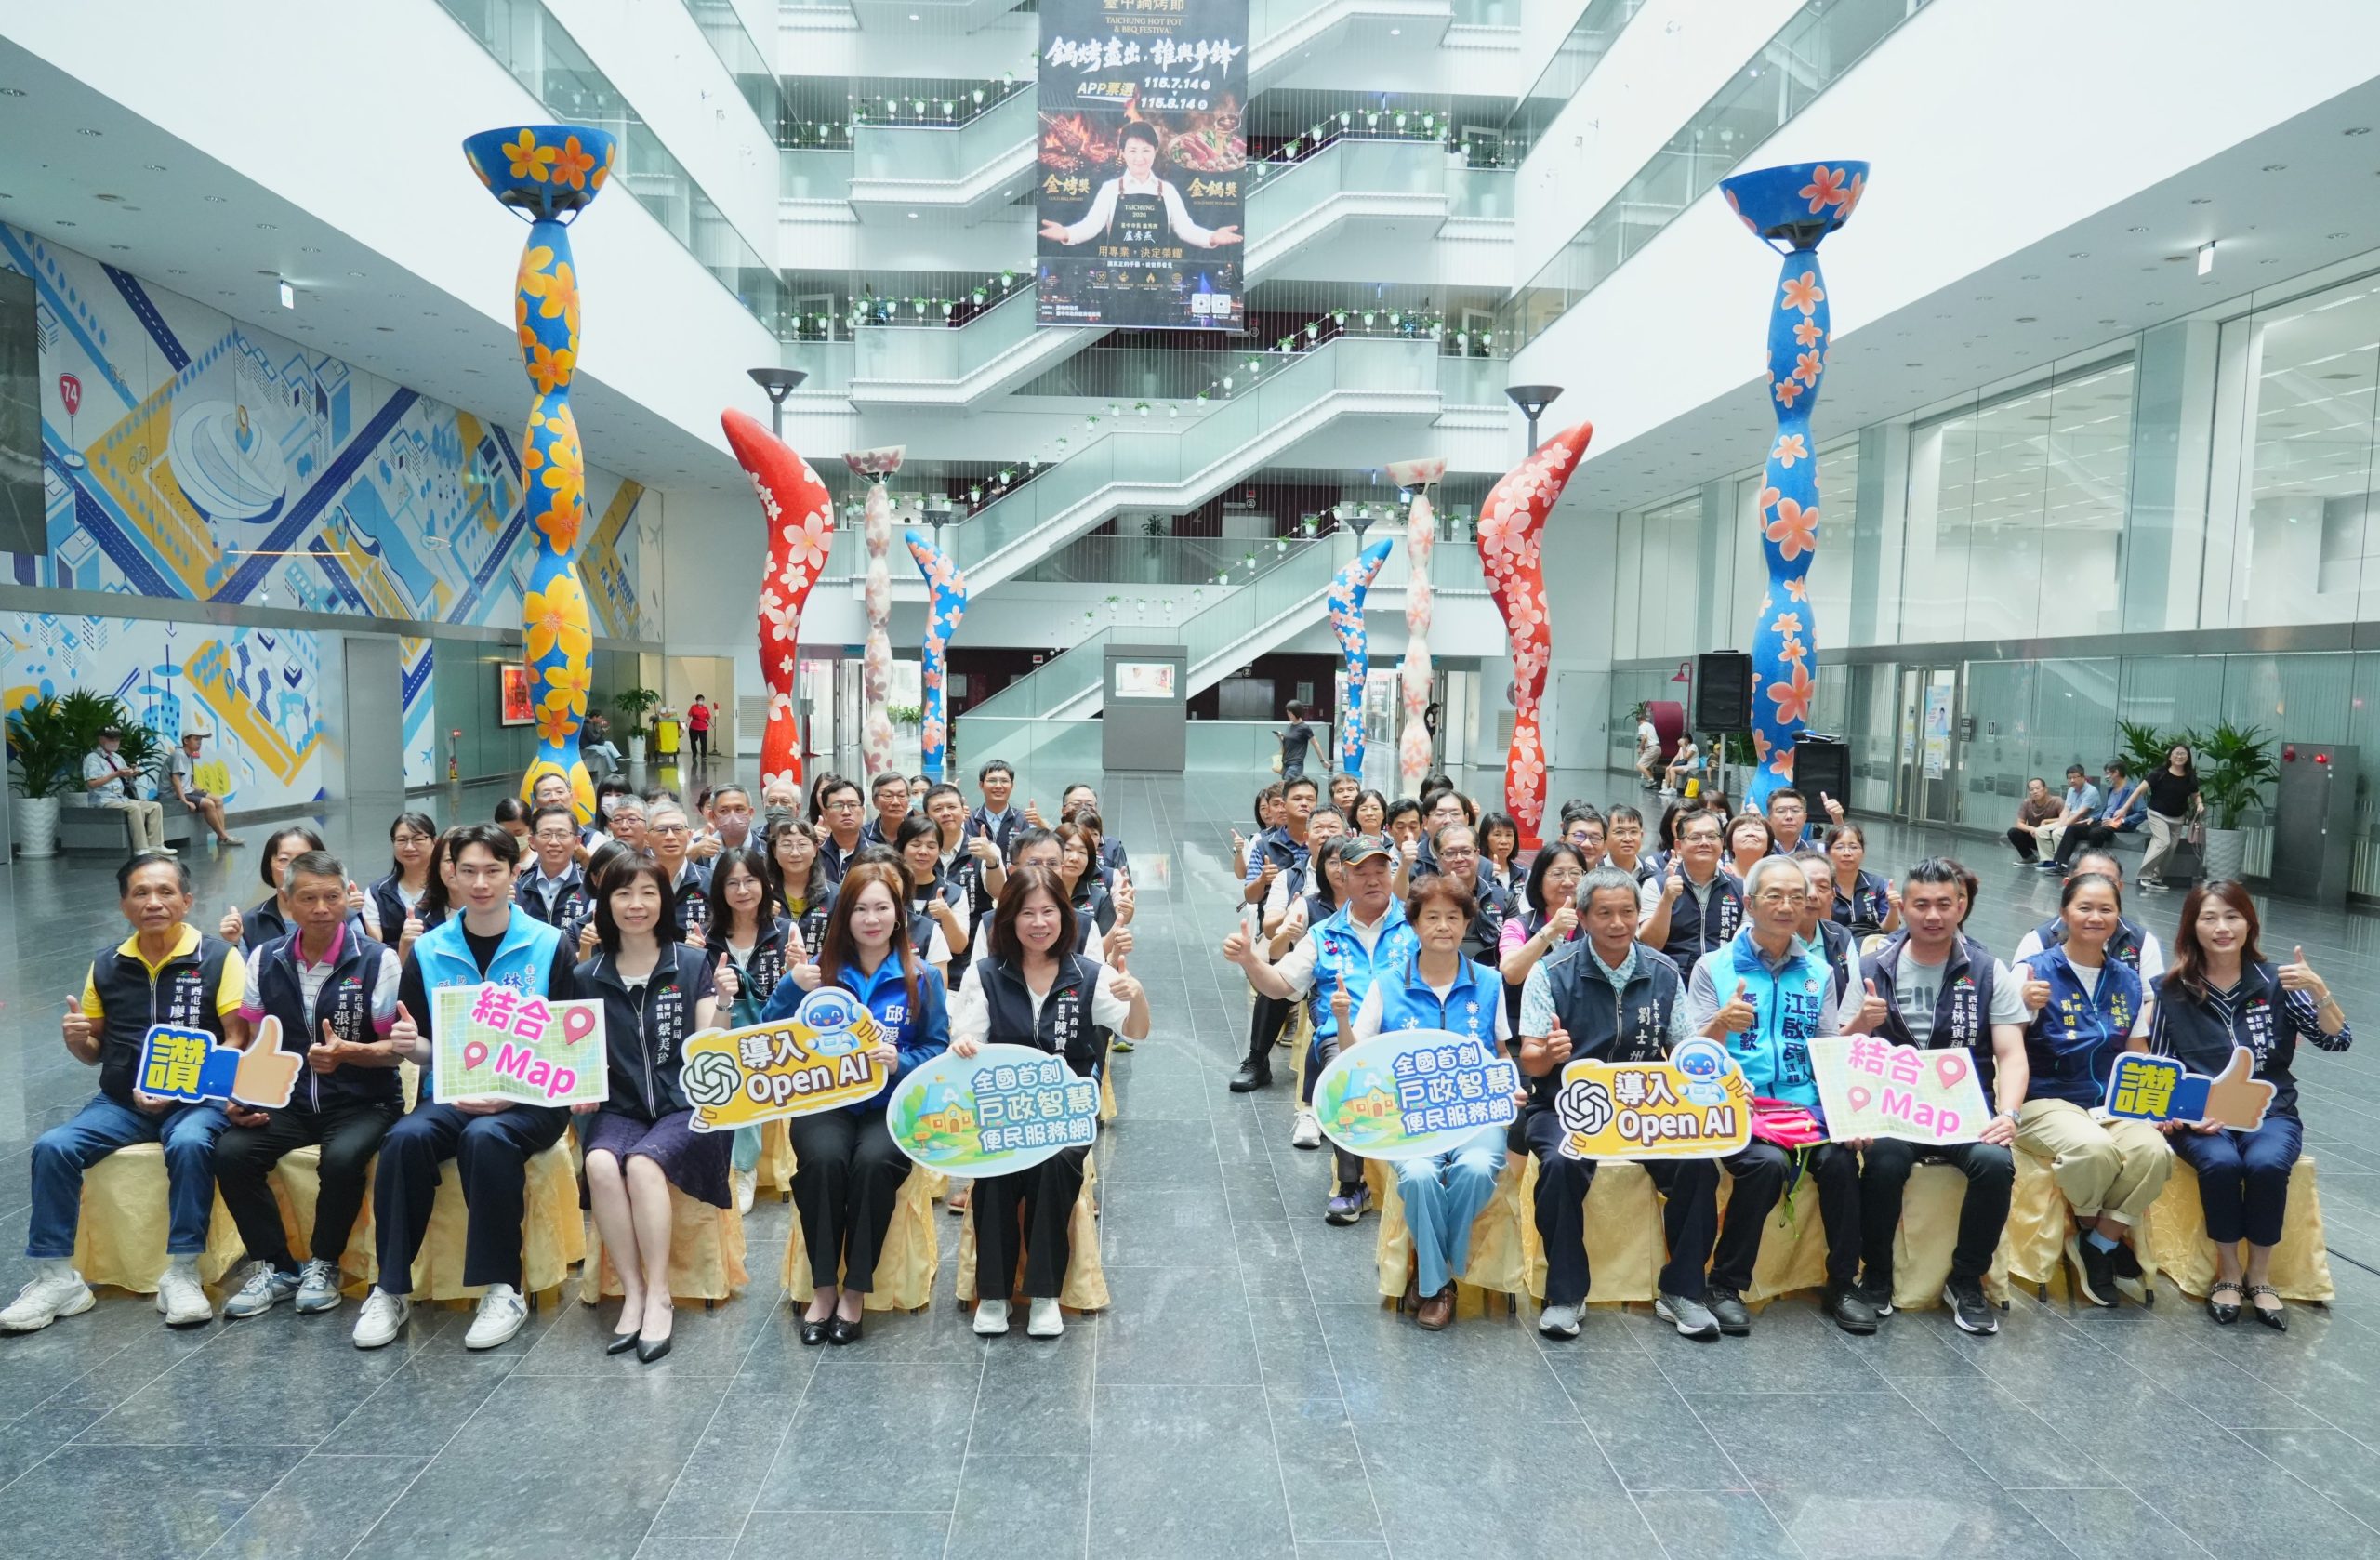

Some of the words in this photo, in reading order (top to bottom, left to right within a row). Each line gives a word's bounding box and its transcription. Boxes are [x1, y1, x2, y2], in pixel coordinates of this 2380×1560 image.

[1122, 26, 1139, 34] BBQ
[1041, 173, 1090, 196] 金烤獎
[1186, 177, 1238, 198] 金鍋獎
[62, 380, 78, 404] 74
[502, 972, 523, 989] 林
[471, 986, 552, 1041] 結合
[673, 1002, 683, 1040] 民政局
[1069, 1004, 1079, 1038] 民政局
[656, 1022, 671, 1065] 蔡美珍
[739, 1030, 809, 1069] 導入
[1054, 1020, 1068, 1057] 陳寶
[1629, 1006, 1651, 1062] 劉士州
[145, 1033, 206, 1094] 讚
[495, 1042, 576, 1099] Map
[973, 1061, 1061, 1092] 全國首創
[1395, 1043, 1480, 1076] 全國首創
[1847, 1037, 1924, 1086] 結合
[746, 1065, 833, 1106] Open
[838, 1052, 871, 1086] AI
[1614, 1071, 1679, 1107] 導入
[2114, 1063, 2177, 1117] 讚
[1404, 1098, 1512, 1134] 便民服務網
[1617, 1108, 1699, 1145] Open
[1703, 1106, 1736, 1138] AI
[1881, 1088, 1960, 1137] Map
[981, 1118, 1091, 1153] 便民服務網
